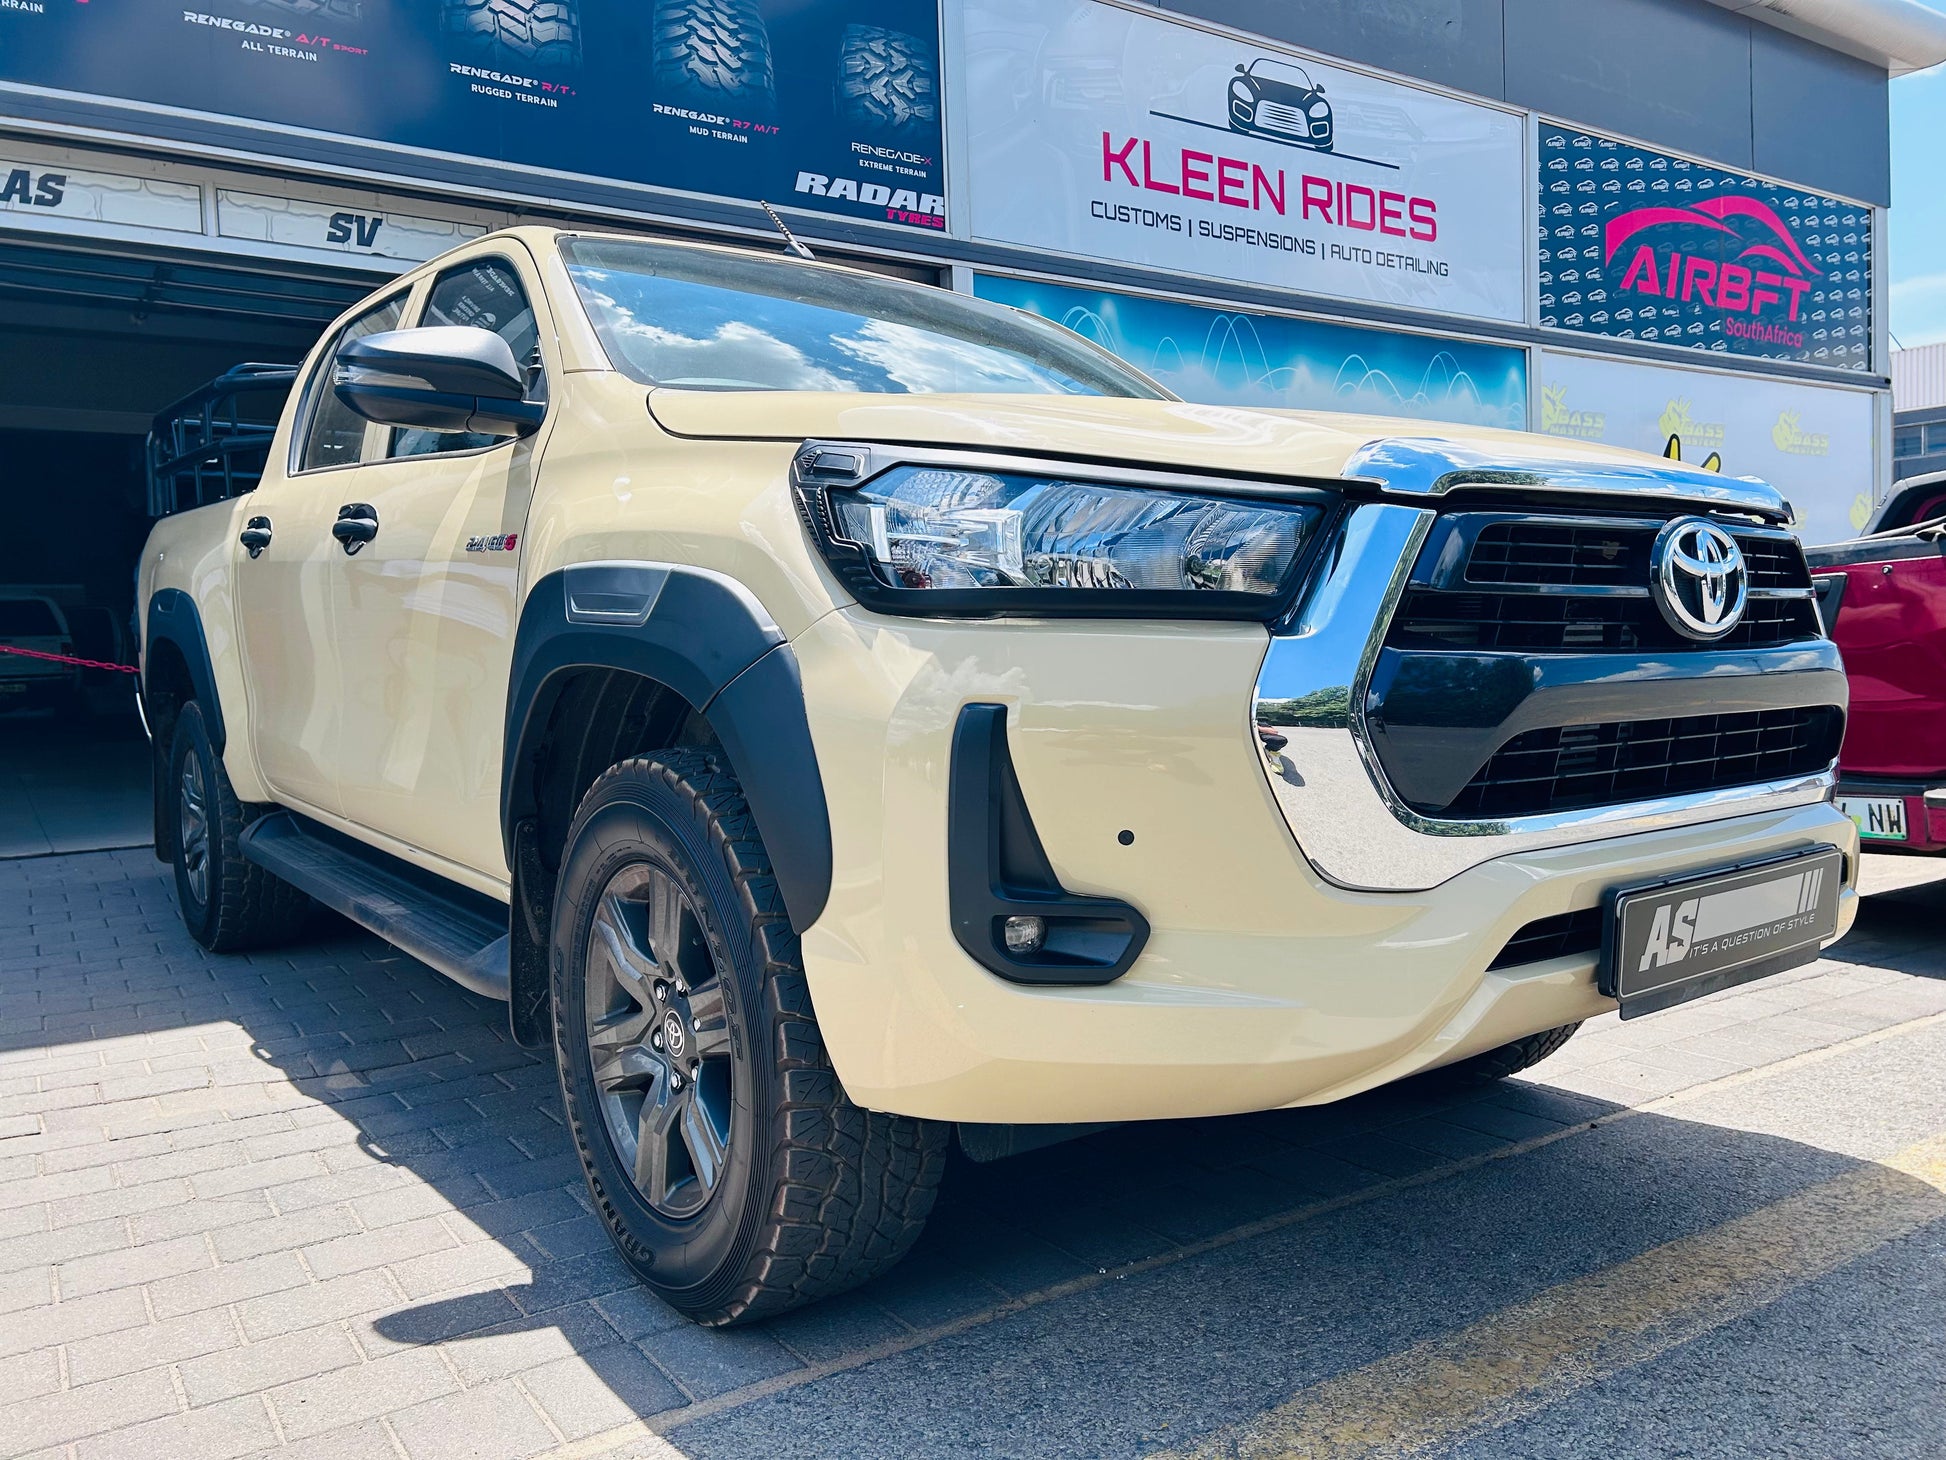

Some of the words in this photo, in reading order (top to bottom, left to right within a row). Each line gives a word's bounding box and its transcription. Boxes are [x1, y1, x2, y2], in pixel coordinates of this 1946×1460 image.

[0, 0, 44, 13] RRAIN
[241, 40, 264, 52] ALL
[267, 44, 317, 62] TERRAIN
[295, 33, 331, 47] A/T
[333, 44, 368, 55] SPORT
[471, 83, 512, 99] RUGGED
[515, 92, 558, 108] TERRAIN
[689, 125, 709, 136] MUD
[712, 130, 748, 144] TERRAIN
[753, 124, 780, 135] M/T
[859, 159, 893, 172] EXTREME
[895, 166, 927, 178] TERRAIN
[1, 169, 67, 207] AS
[795, 171, 944, 216] RADAR
[1102, 131, 1286, 216] KLEEN
[1302, 175, 1438, 242] RIDES
[326, 212, 383, 248] SV
[886, 208, 944, 228] TYRES
[1091, 200, 1182, 232] CUSTOMS
[1198, 221, 1316, 255] SUSPENSIONS
[1330, 244, 1372, 264] AUTO
[1376, 252, 1449, 277] DETAILING
[1620, 245, 1811, 322] AIRBFT
[1726, 317, 1802, 348] SouthAfrica
[1559, 410, 1605, 428] BASS
[1683, 422, 1725, 439] BASS
[1867, 803, 1902, 833] NW
[1638, 897, 1700, 972] AS
[1688, 943, 1708, 960] IT'S
[1710, 941, 1719, 954] A
[1721, 926, 1771, 950] QUESTION
[1772, 922, 1786, 936] OF
[1787, 912, 1815, 931] STYLE
